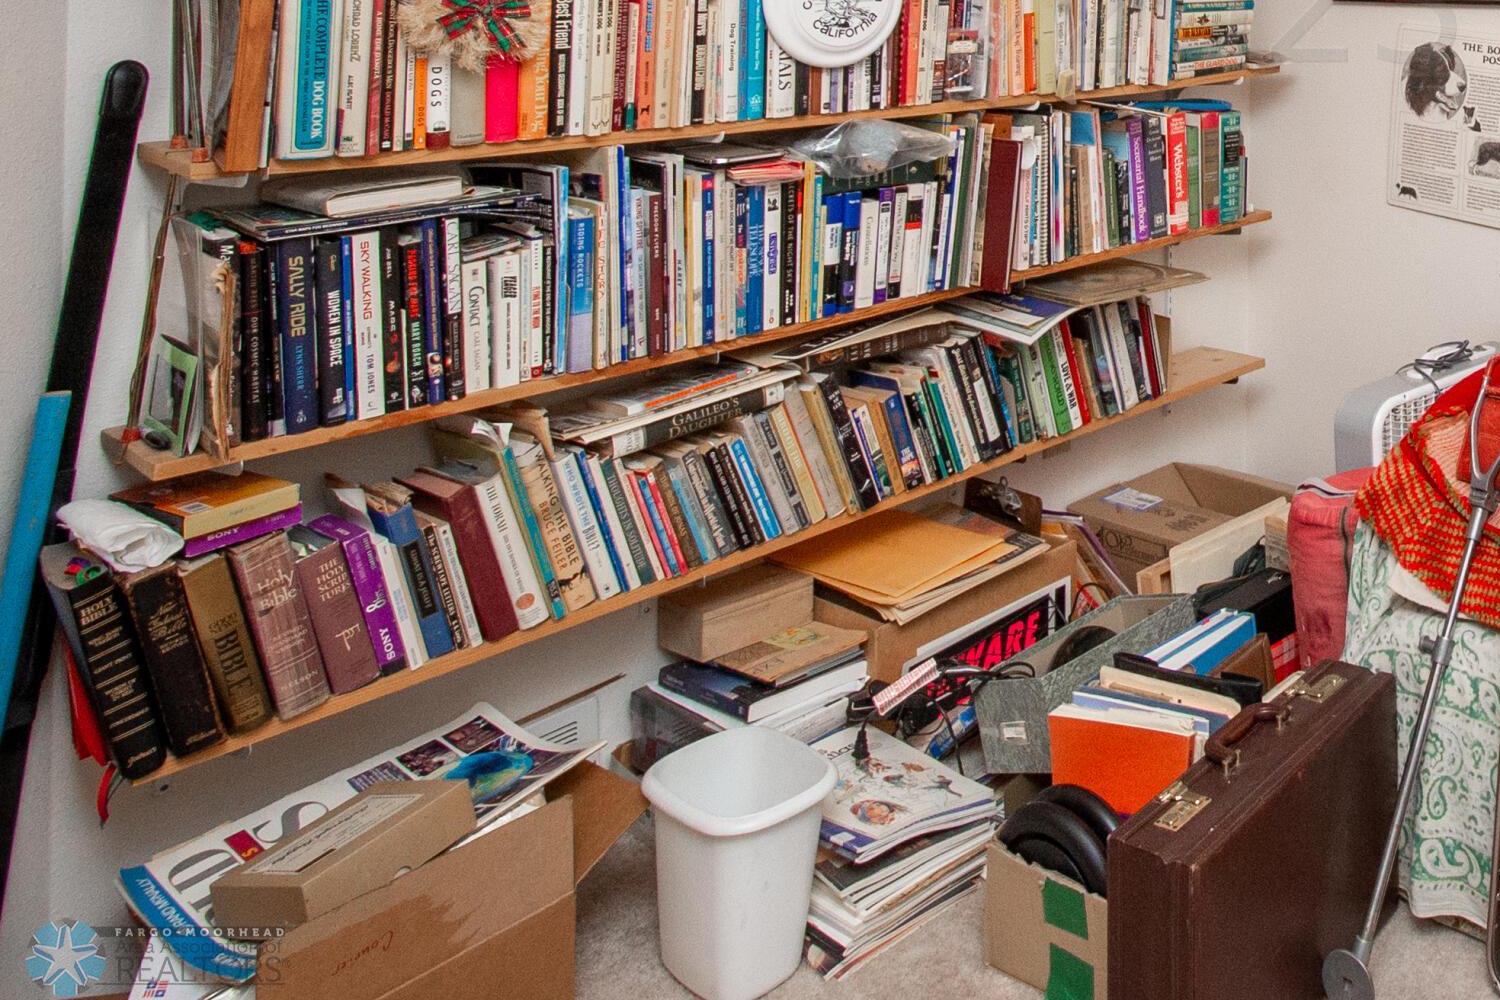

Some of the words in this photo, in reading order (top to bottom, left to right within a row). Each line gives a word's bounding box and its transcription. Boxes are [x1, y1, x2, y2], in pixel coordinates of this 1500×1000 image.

[313, 17, 329, 79] COMPLETE
[349, 28, 362, 63] LORENZ
[554, 19, 571, 49] Friend
[1462, 42, 1484, 52] THE
[727, 39, 736, 71] Training
[311, 80, 325, 106] DOG
[430, 66, 442, 107] DOGS
[309, 106, 324, 139] BOOK
[1131, 136, 1145, 183] Secretarial
[1172, 143, 1186, 198] Webster's
[634, 197, 642, 218] VIKING
[1135, 186, 1148, 233] Handbook
[445, 221, 459, 259] CARL
[577, 222, 585, 251] RIDING
[635, 220, 643, 250] SPITFIRE
[360, 241, 370, 263] SKY
[286, 255, 305, 298] SALLY
[576, 253, 584, 288] ROCKETS
[360, 265, 372, 319] WALKING
[447, 263, 461, 312] SAGAN
[503, 275, 517, 298] YEAGER
[288, 301, 306, 337] RIDE
[327, 289, 341, 323] WOMEN
[467, 285, 486, 327] CONTACT
[329, 325, 341, 336] IN
[410, 321, 420, 341] MARY
[250, 336, 258, 367] COSMIC
[329, 337, 342, 367] SPACE
[365, 354, 374, 369] TOM
[411, 342, 422, 367] ROACH
[250, 369, 259, 404] HABITAT
[366, 371, 376, 394] JONES
[668, 407, 743, 438] DAUGHTER
[671, 395, 740, 427] GALILEO'S
[532, 450, 560, 506] WALKING
[562, 460, 576, 482] WHO
[485, 485, 498, 501] THE
[570, 482, 586, 511] WROTE
[490, 503, 508, 533] TORAH
[552, 508, 569, 532] THE
[579, 510, 592, 528] THE
[206, 526, 241, 542] SONY
[426, 533, 437, 546] The
[537, 500, 557, 535] BRUCE
[548, 536, 569, 570] FEILER
[560, 532, 580, 566] BIBLE
[581, 524, 602, 552] BIBLE?
[316, 562, 343, 584] HOLY
[319, 557, 339, 573] THE
[430, 546, 449, 586] SCREWTAPE
[257, 570, 296, 593] Holy
[318, 581, 352, 602] TURES
[80, 595, 113, 616] HOLY
[260, 586, 298, 609] Bible
[442, 586, 457, 615] LETTERS
[81, 603, 118, 625] BIBLE
[375, 625, 399, 660] SONY
[161, 904, 187, 930] RAND
[332, 926, 395, 977] Courier
